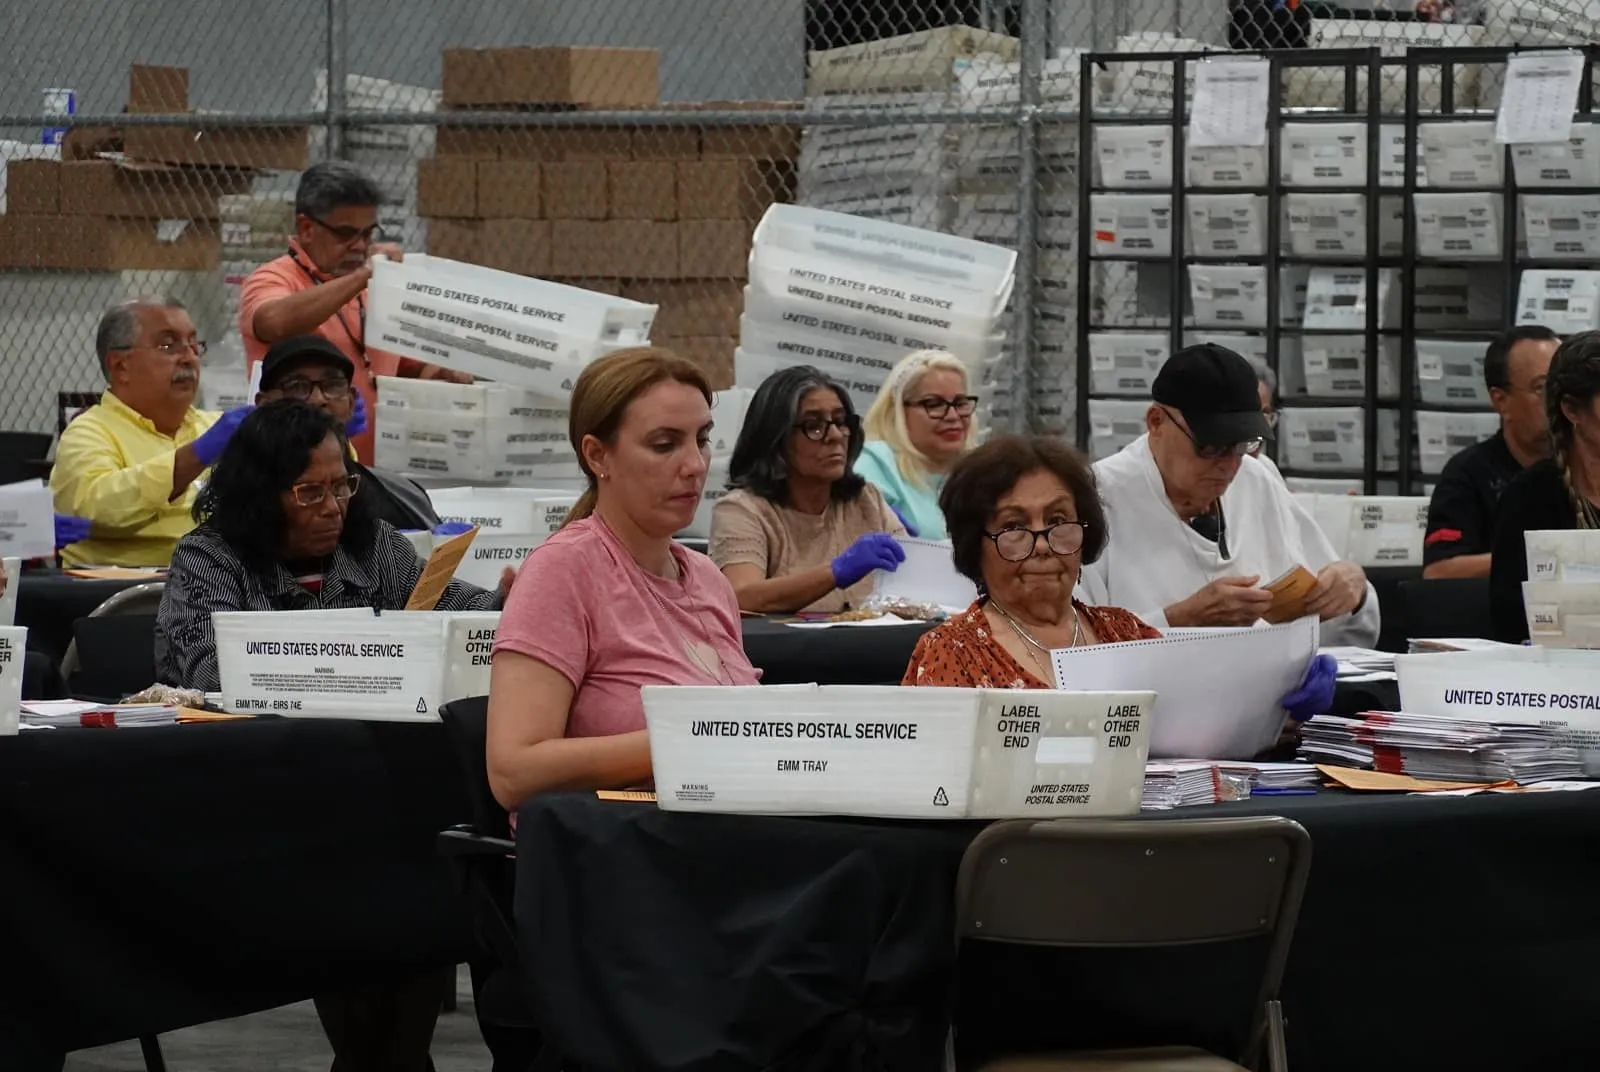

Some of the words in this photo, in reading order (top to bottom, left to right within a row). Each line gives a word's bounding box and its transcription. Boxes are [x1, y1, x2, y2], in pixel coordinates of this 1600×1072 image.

[790, 268, 826, 282] UNITED
[828, 276, 865, 291] STATES
[868, 284, 905, 300] POSTAL
[910, 293, 953, 309] SERVICE
[406, 282, 442, 296] UNITED
[444, 289, 479, 304] STATES
[481, 298, 519, 313] POSTAL
[522, 306, 566, 322] SERVICE
[788, 285, 824, 300] UNITED
[826, 294, 864, 310] STATES
[866, 304, 904, 319] POSTAL
[907, 313, 952, 329] SERVICE
[401, 302, 436, 318] UNITED
[438, 312, 473, 329] STATES
[475, 321, 512, 340] POSTAL
[516, 333, 559, 351] SERVICE
[782, 311, 819, 327] UNITED
[821, 320, 857, 336] STATES
[860, 328, 897, 344] POSTAL
[777, 341, 815, 355] UNITED
[816, 348, 854, 362] STATES
[853, 382, 881, 393] POST
[474, 548, 513, 560] UNITED
[468, 629, 496, 640] LABE
[246, 642, 280, 655] UNITED
[283, 643, 318, 656] STATES
[320, 643, 358, 657] POSTAL
[361, 644, 404, 657] SERVICE
[466, 642, 493, 652] OTH
[236, 699, 250, 708] EMM
[251, 700, 267, 709] TRAY
[274, 700, 288, 709] EIRS
[1444, 689, 1492, 705] UNITED
[1496, 692, 1546, 708] STATES
[1550, 694, 1600, 710] POSTAL
[1001, 705, 1041, 718] LABEL
[1107, 705, 1141, 717] LABEL
[692, 721, 739, 736] UNITED
[742, 722, 794, 738] STATES
[797, 723, 852, 739] POSTAL
[855, 723, 917, 739] SERVICE
[997, 720, 1040, 733] OTHER
[1104, 720, 1139, 732] OTHER
[1004, 736, 1029, 748] END
[1108, 736, 1130, 747] END
[777, 760, 800, 771] EMM
[802, 760, 828, 772] TRAY
[1030, 784, 1059, 793] UNITED
[1060, 784, 1089, 793] STATES
[1025, 796, 1054, 804] POSTAL
[1056, 795, 1090, 804] SERVICE
